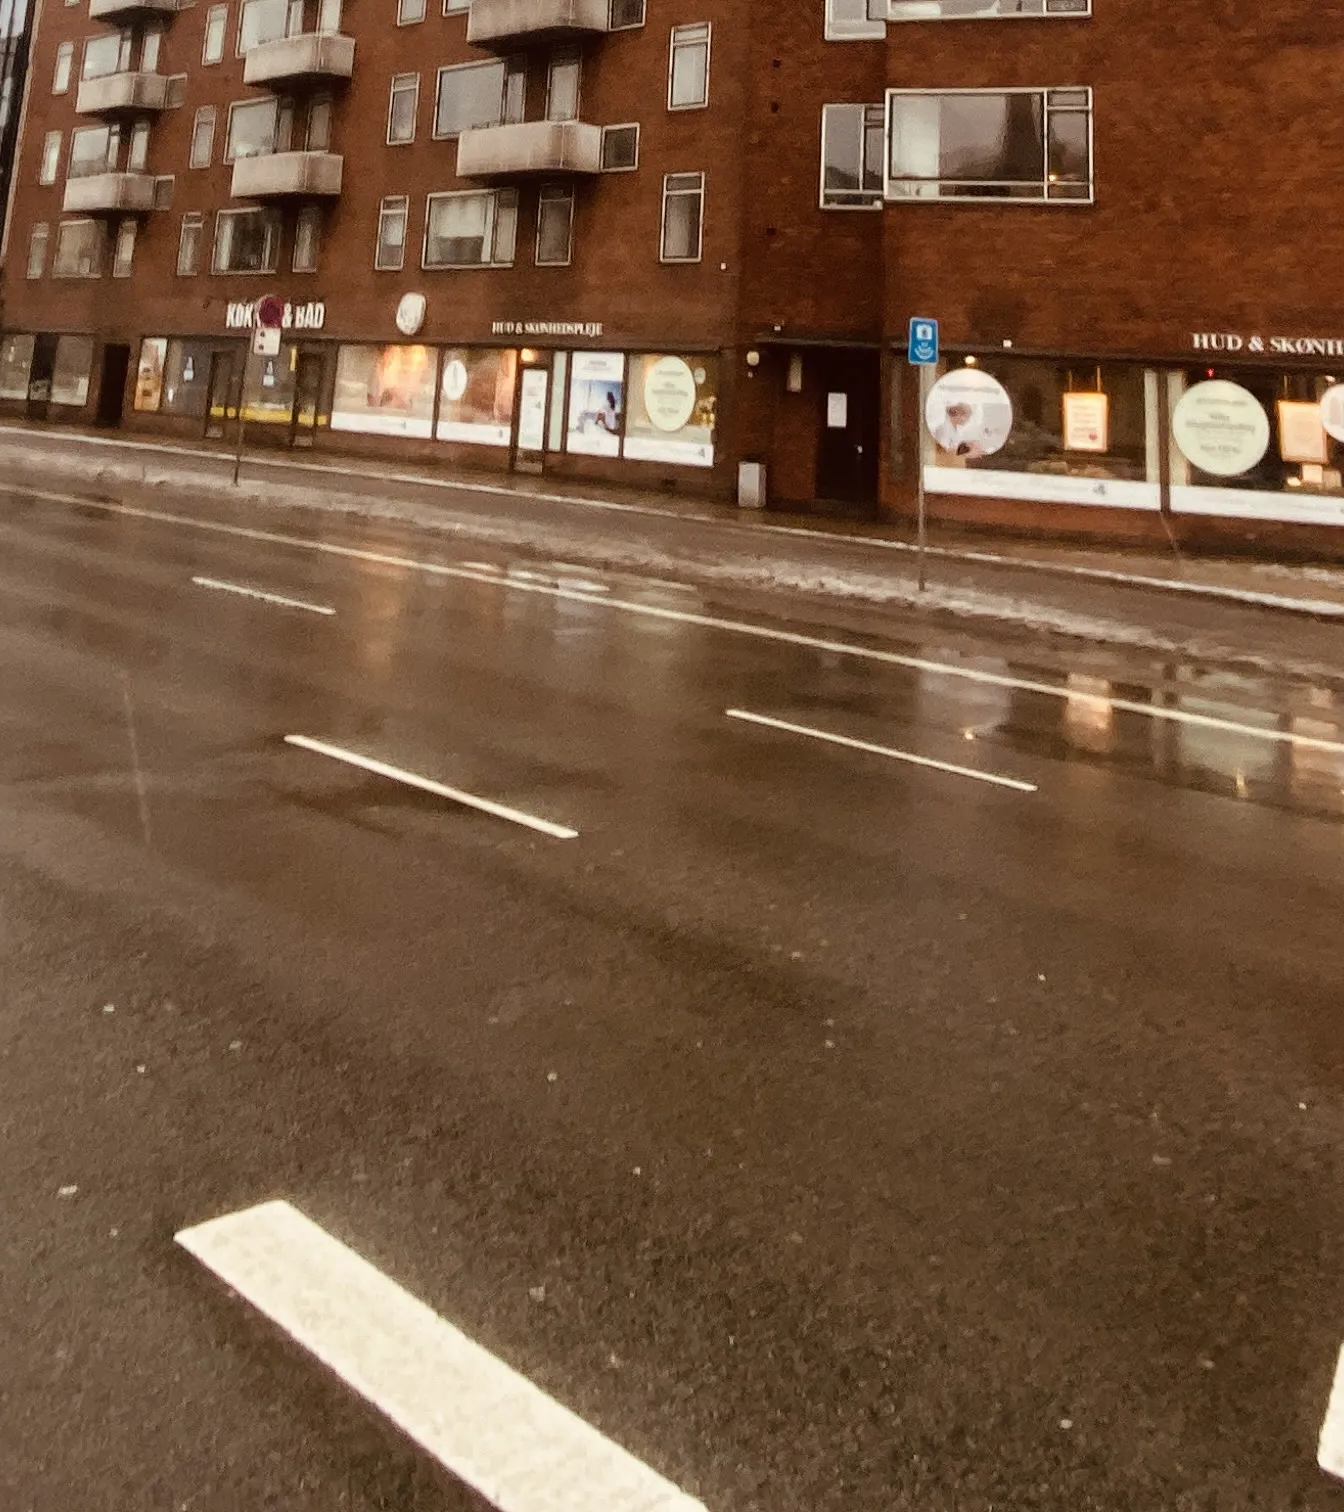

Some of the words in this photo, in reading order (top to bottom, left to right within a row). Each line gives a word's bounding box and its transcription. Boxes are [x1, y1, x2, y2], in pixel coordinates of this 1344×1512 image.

[282, 302, 293, 328] &
[1191, 332, 1243, 351] HUD
[1248, 335, 1265, 352] &
